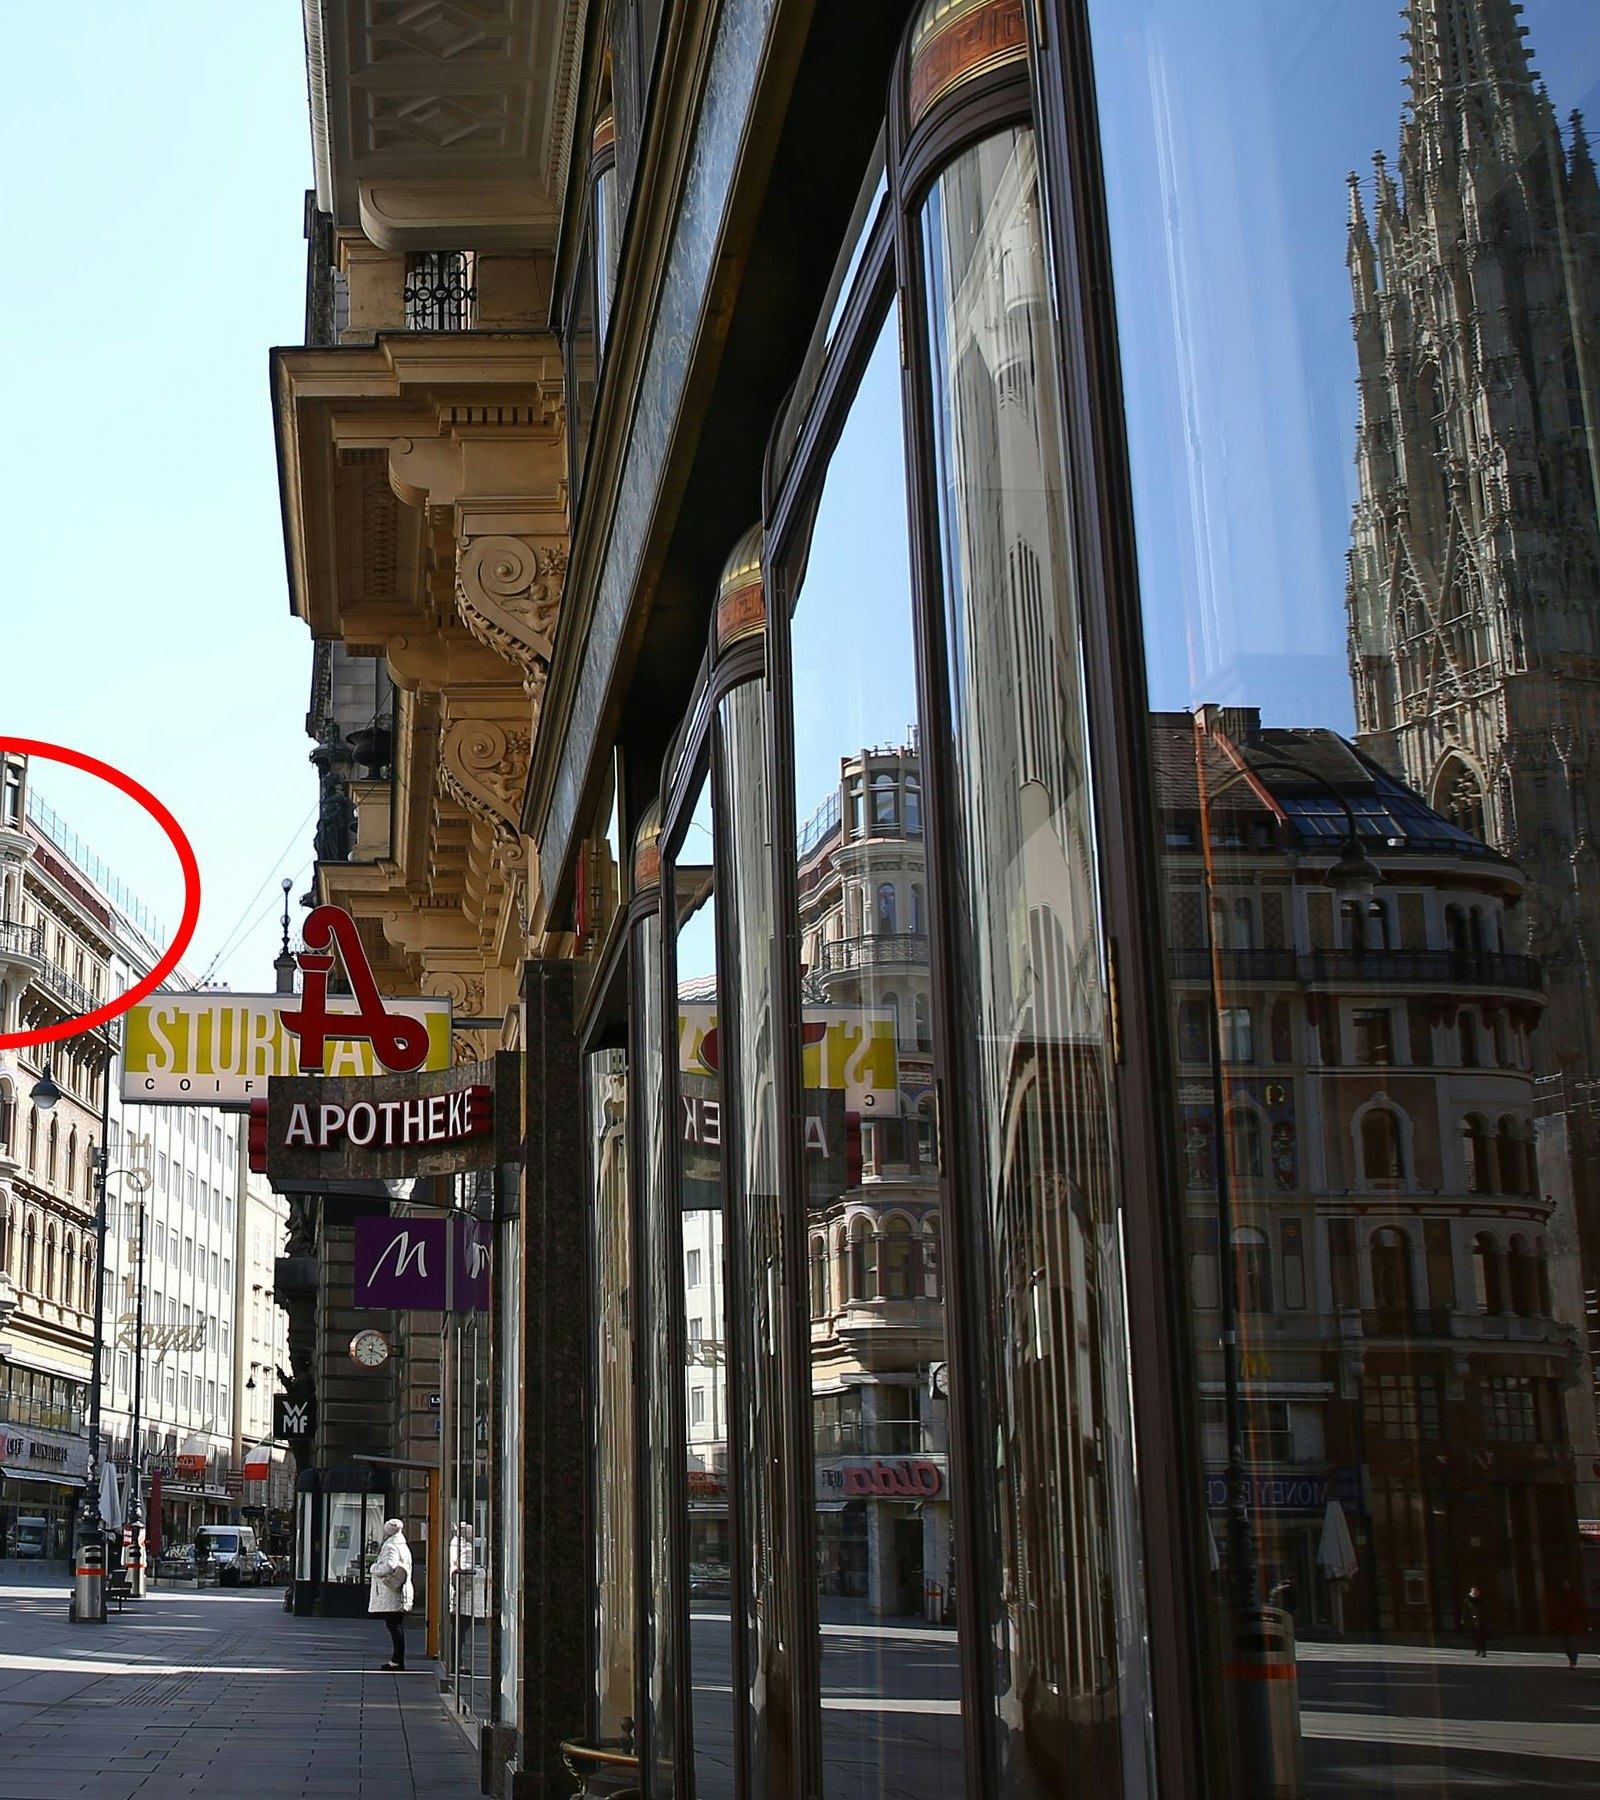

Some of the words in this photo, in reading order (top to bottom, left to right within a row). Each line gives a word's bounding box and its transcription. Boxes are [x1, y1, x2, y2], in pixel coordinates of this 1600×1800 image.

[144, 1078, 254, 1093] COIF
[285, 1087, 473, 1146] APOTHEKE
[126, 1133, 152, 1300] HOTEL
[116, 1313, 208, 1367] Royal
[283, 1401, 308, 1433] WMF
